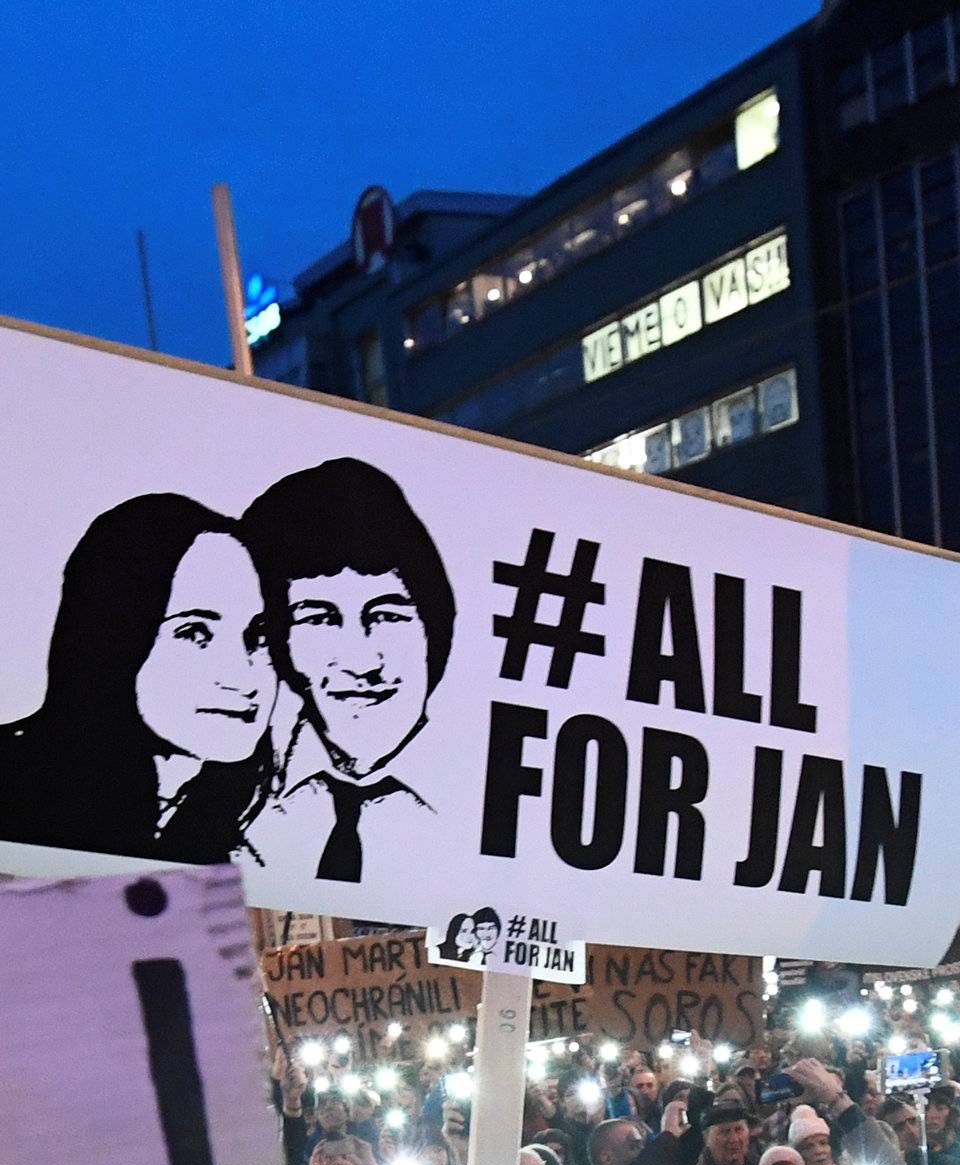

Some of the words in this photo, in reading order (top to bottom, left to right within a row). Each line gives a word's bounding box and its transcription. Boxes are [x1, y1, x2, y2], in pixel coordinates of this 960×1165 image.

[492, 527, 818, 734] #ALL
[480, 700, 711, 882] FOR
[733, 745, 923, 907] JAN
[507, 914, 558, 944] #ALL
[265, 943, 325, 982] JAN
[342, 935, 428, 976] MART
[503, 940, 540, 967] FOR
[543, 946, 575, 972] JAN
